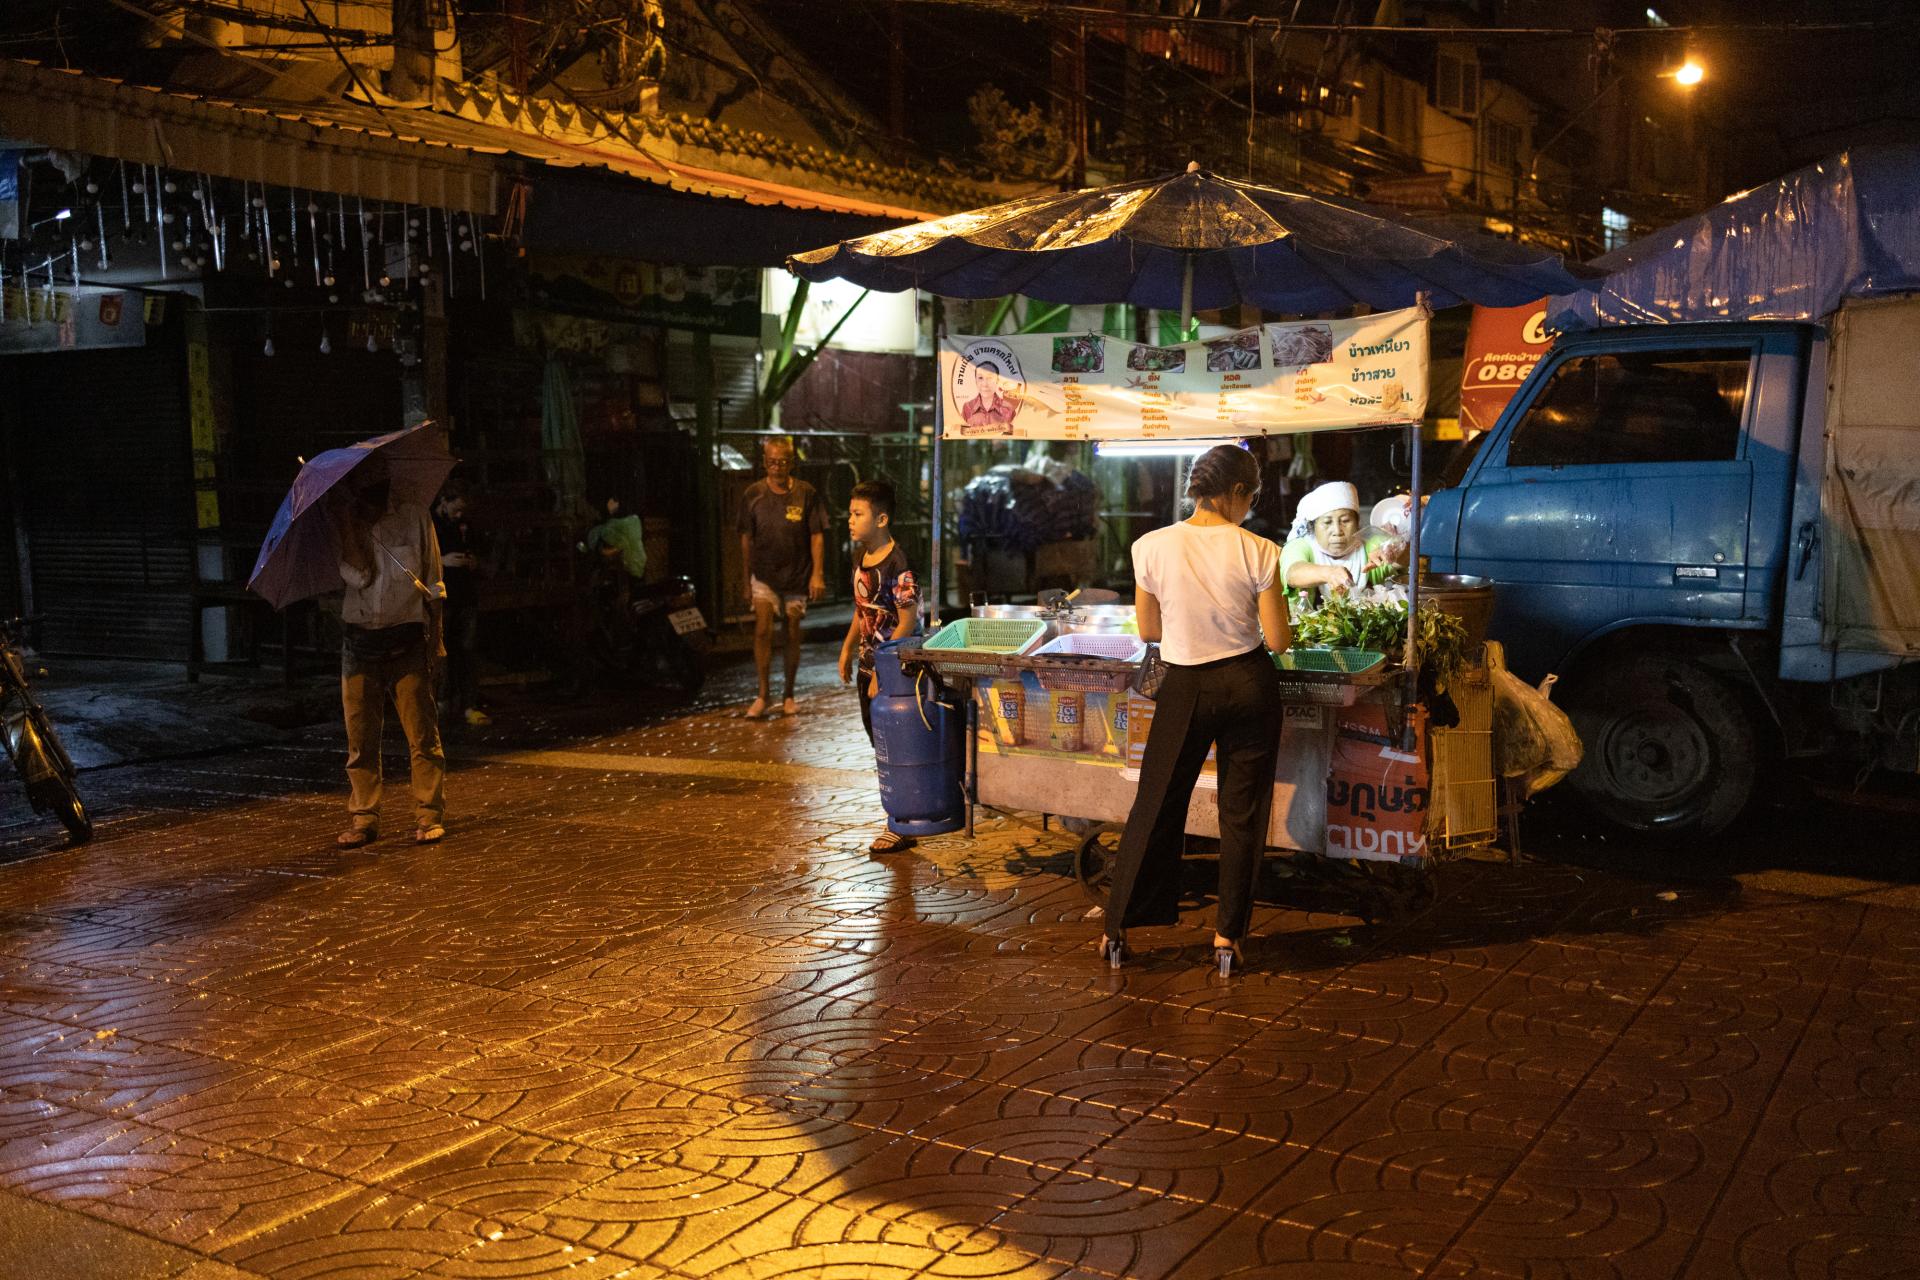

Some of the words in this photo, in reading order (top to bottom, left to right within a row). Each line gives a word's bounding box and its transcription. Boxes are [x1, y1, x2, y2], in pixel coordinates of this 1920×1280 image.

[1349, 339, 1410, 358] ข้าวเหนียว
[1351, 367, 1396, 383] ข้าวสวย
[1057, 705, 1077, 714] Ice
[1057, 713, 1077, 723] Tea
